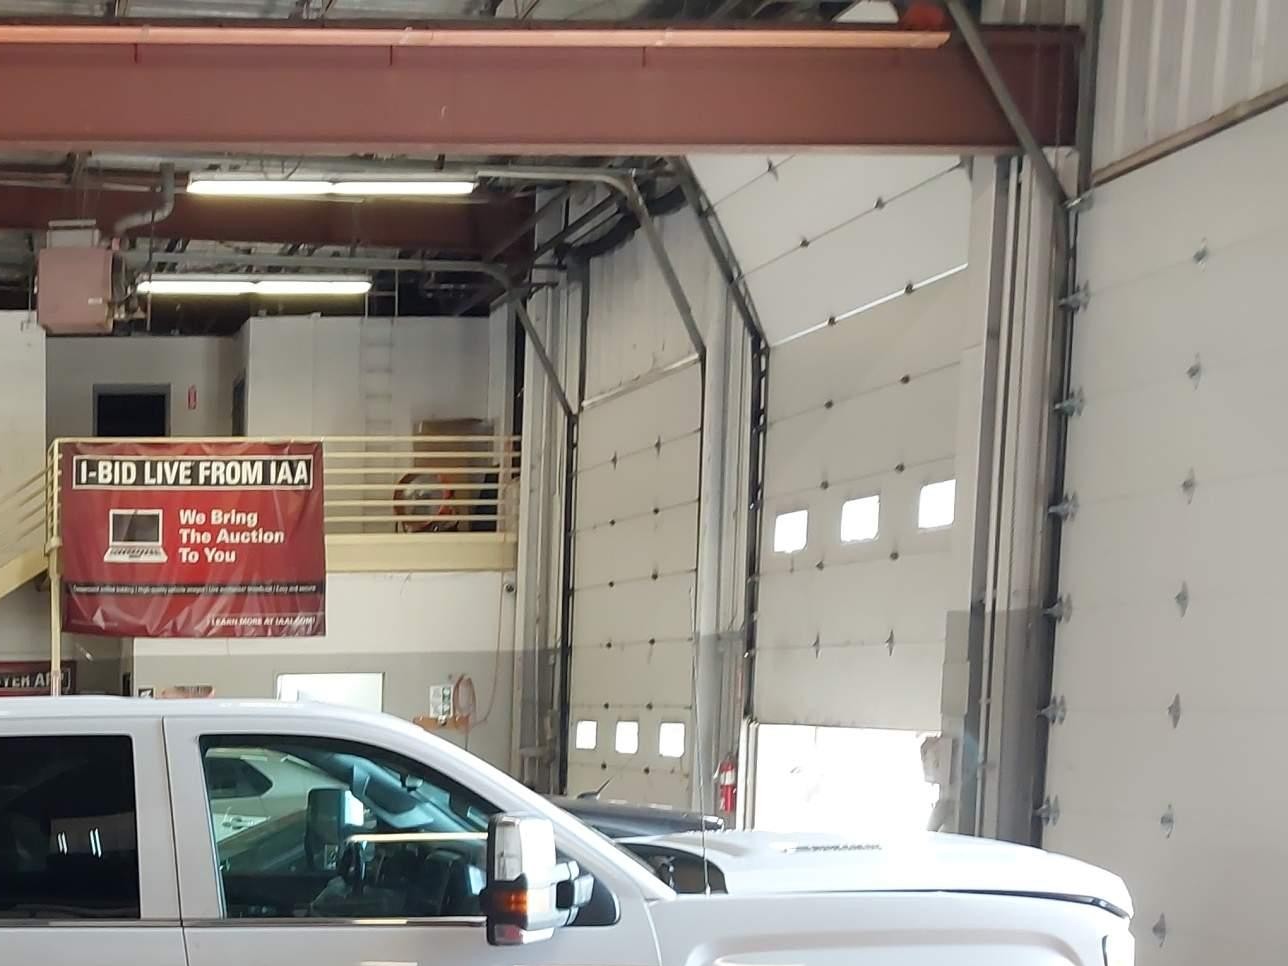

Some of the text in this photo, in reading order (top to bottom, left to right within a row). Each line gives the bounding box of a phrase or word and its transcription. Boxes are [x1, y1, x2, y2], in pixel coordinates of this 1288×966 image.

[80, 460, 309, 485] I-BID LIVE FROM IAA
[178, 509, 258, 528] We Bring
[178, 528, 285, 544] The Auction
[178, 548, 236, 563] To You
